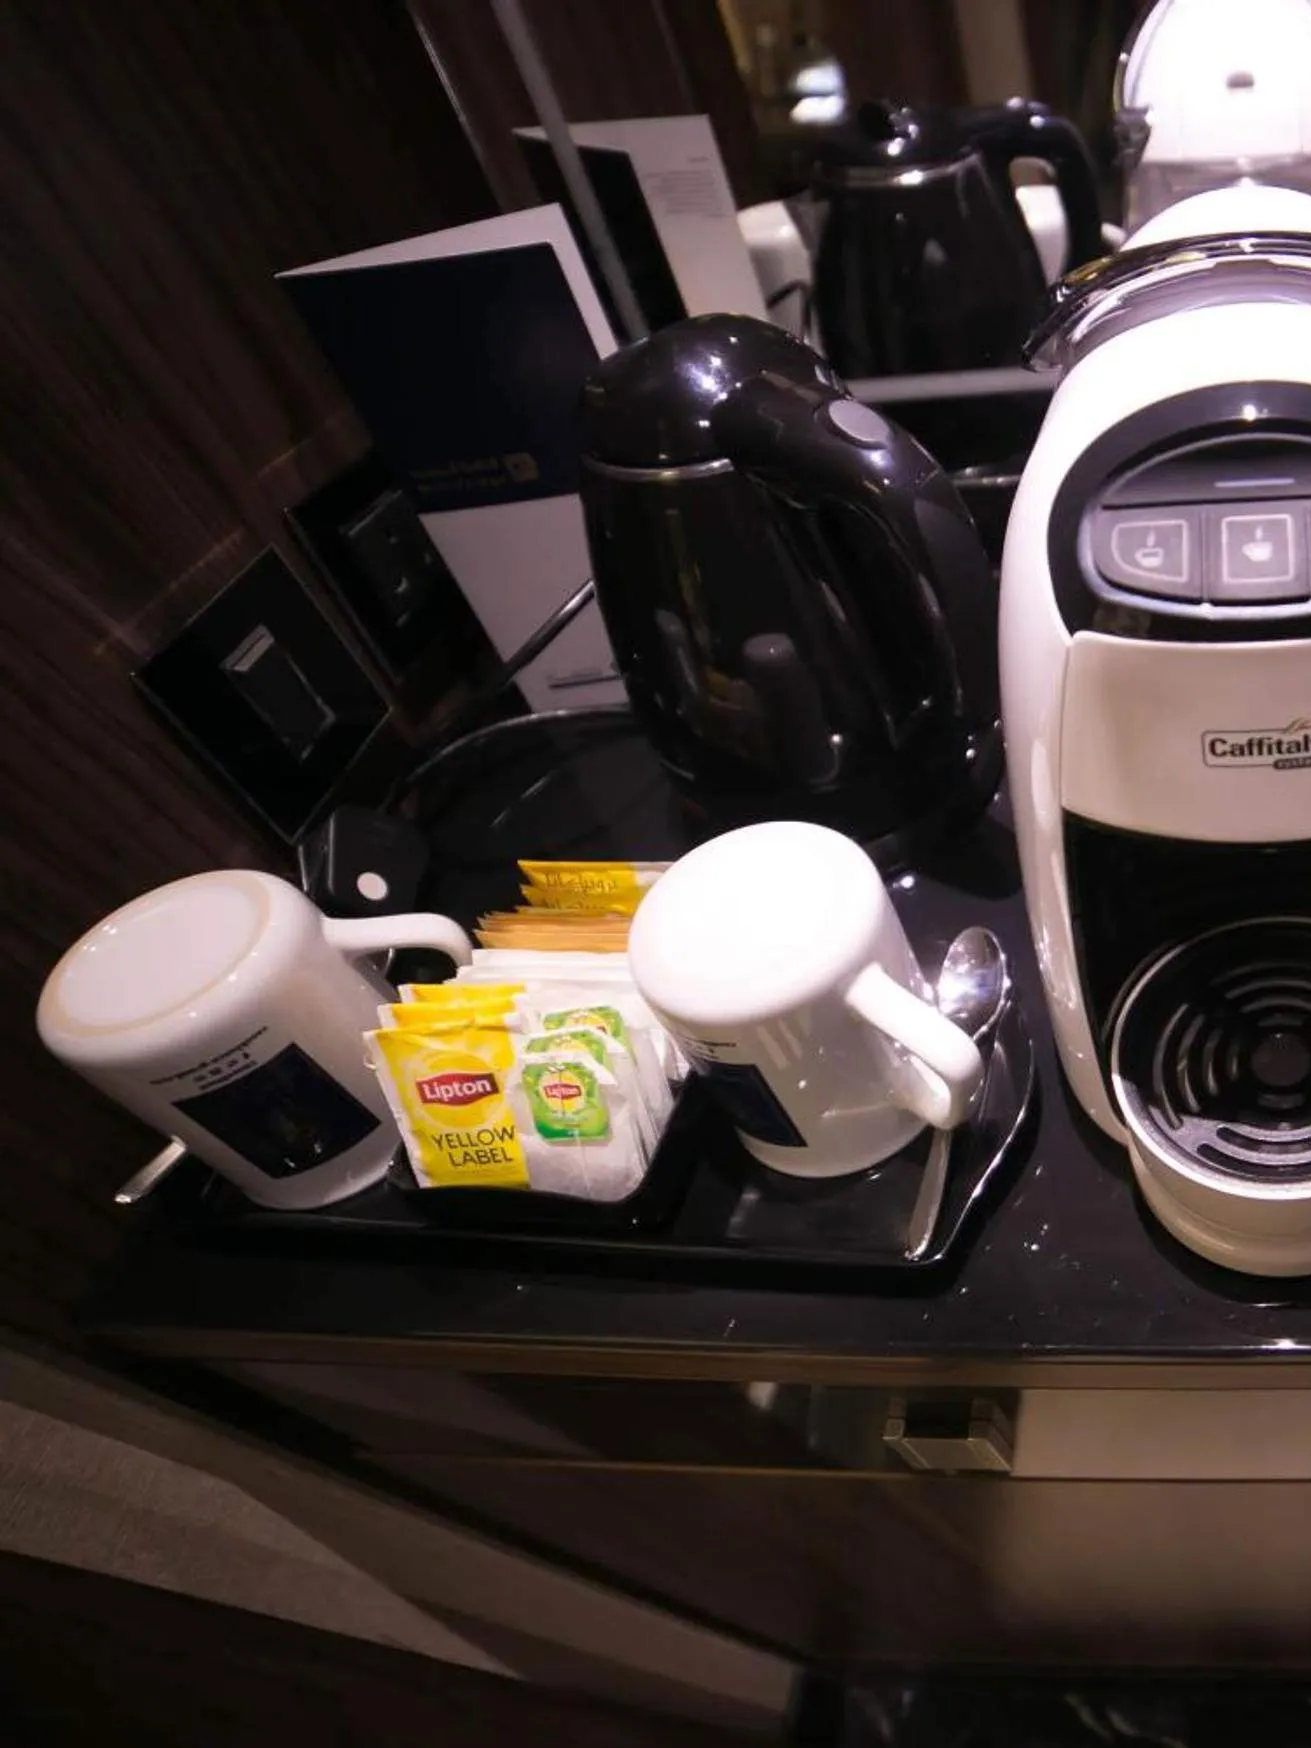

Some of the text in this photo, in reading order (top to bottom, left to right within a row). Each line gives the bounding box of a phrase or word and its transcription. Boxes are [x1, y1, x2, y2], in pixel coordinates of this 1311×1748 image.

[422, 1079, 493, 1102] Lipton
[431, 1125, 515, 1151] YELLOW
[448, 1147, 514, 1167] LABEL
